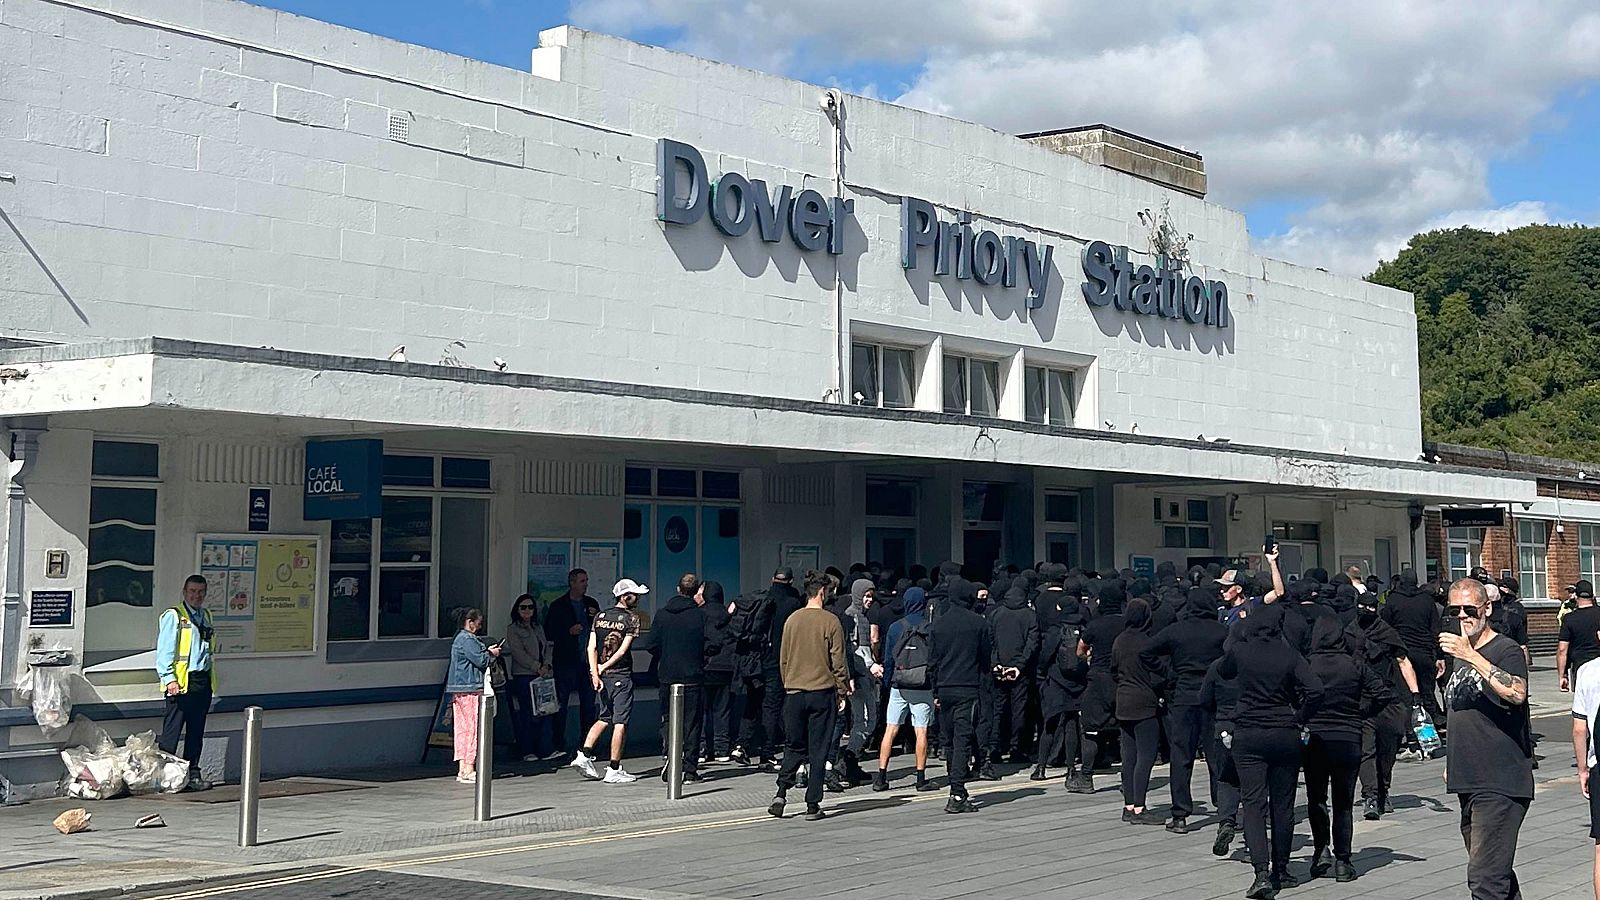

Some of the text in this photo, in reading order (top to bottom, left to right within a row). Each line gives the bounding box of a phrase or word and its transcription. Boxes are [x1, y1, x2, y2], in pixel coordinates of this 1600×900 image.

[656, 138, 1229, 328] Dover Priory Station
[308, 463, 337, 480] CAFÉ
[307, 480, 345, 493] LOCAL
[595, 620, 625, 631] ENGLAND
